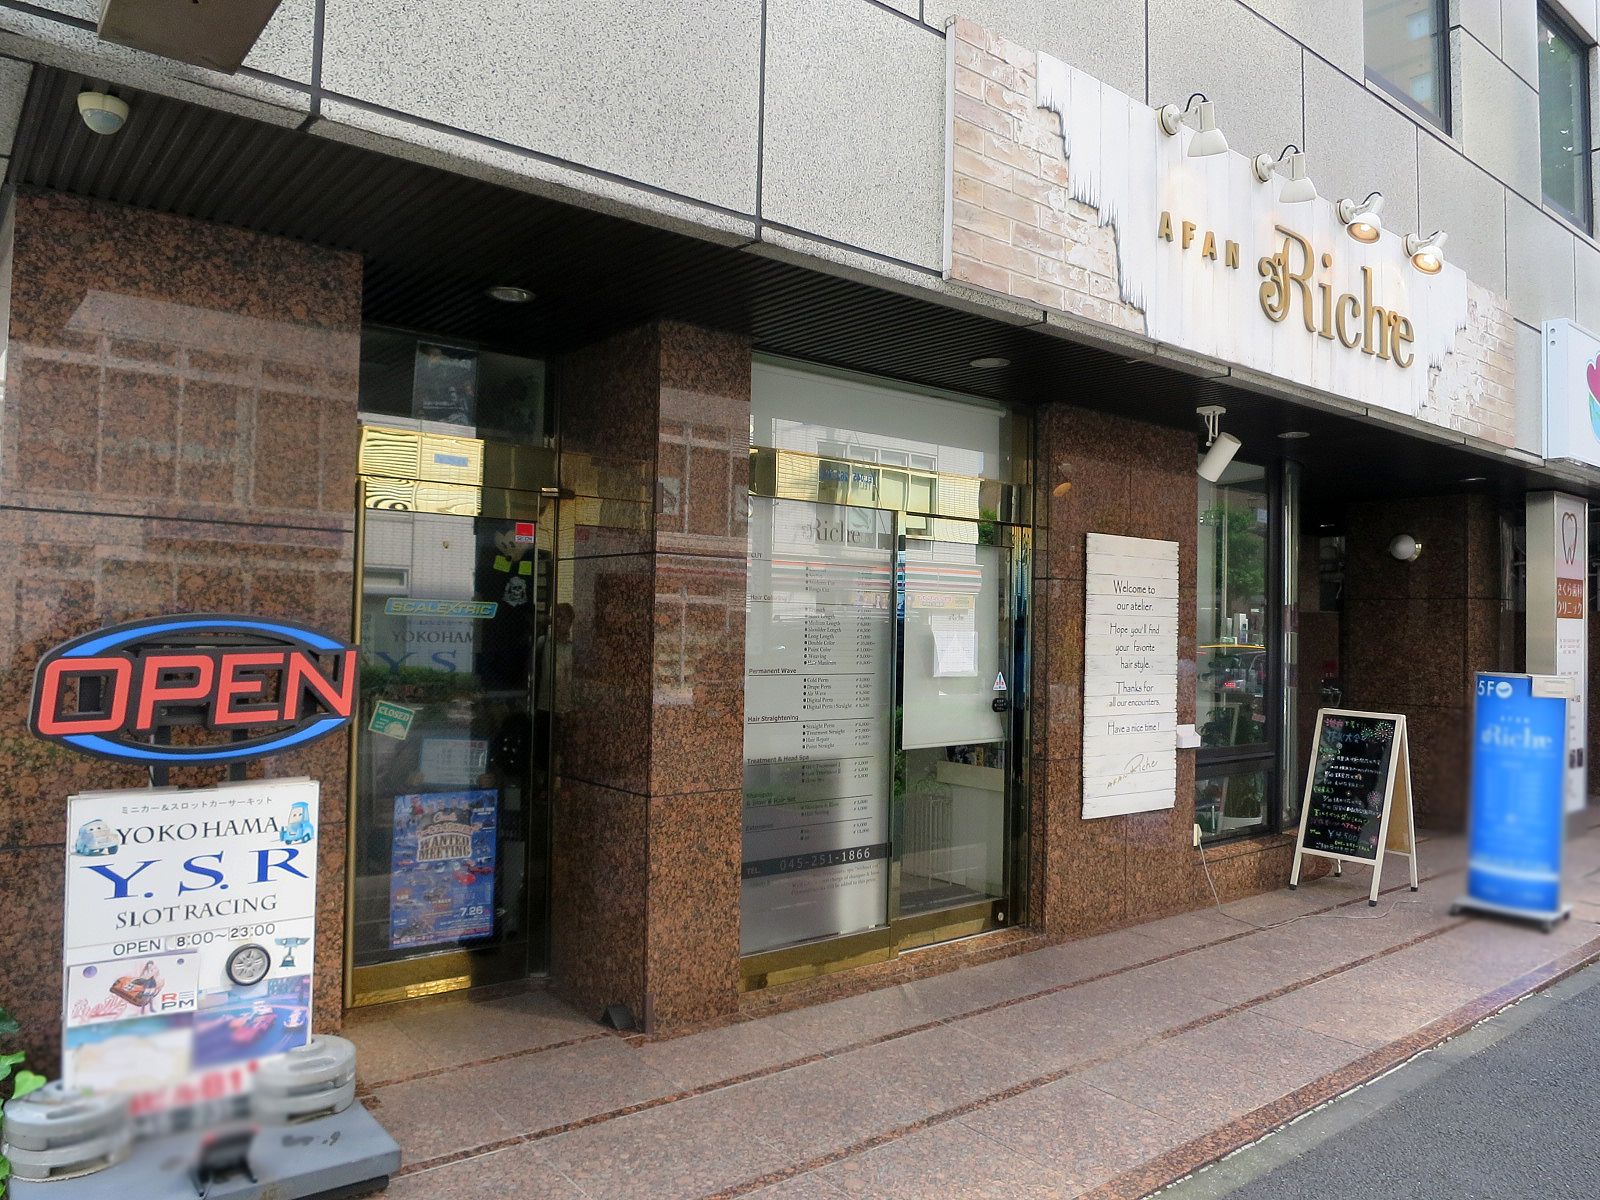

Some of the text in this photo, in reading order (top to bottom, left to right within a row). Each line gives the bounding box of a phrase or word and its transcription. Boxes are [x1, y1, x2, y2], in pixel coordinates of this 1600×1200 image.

[1158, 211, 1415, 369] AFAN Riche
[1113, 579, 1156, 594] Welcome to
[391, 600, 493, 616] SCALEXTRIC
[1116, 598, 1154, 611] our atelier.
[1109, 622, 1128, 637] Hope
[1148, 623, 1160, 634] find
[392, 631, 474, 645] YOKOHAM
[1115, 640, 1156, 656] your favorite
[1120, 657, 1133, 669] hair
[780, 667, 797, 675] Wave
[37, 650, 357, 736] OPEN
[1116, 680, 1154, 694] Thanks for
[378, 705, 410, 721] CLOSED
[761, 714, 799, 722] Straightening
[1107, 721, 1125, 735] Have
[1131, 723, 1143, 732] nice
[747, 756, 777, 764] Treatment
[116, 817, 279, 846] YOKOHAMA
[420, 834, 470, 849] WANTED
[418, 845, 471, 861] MEETING
[779, 847, 871, 871] 045-251-1866
[459, 905, 483, 917] 7.26
[112, 938, 161, 957] OPEN
